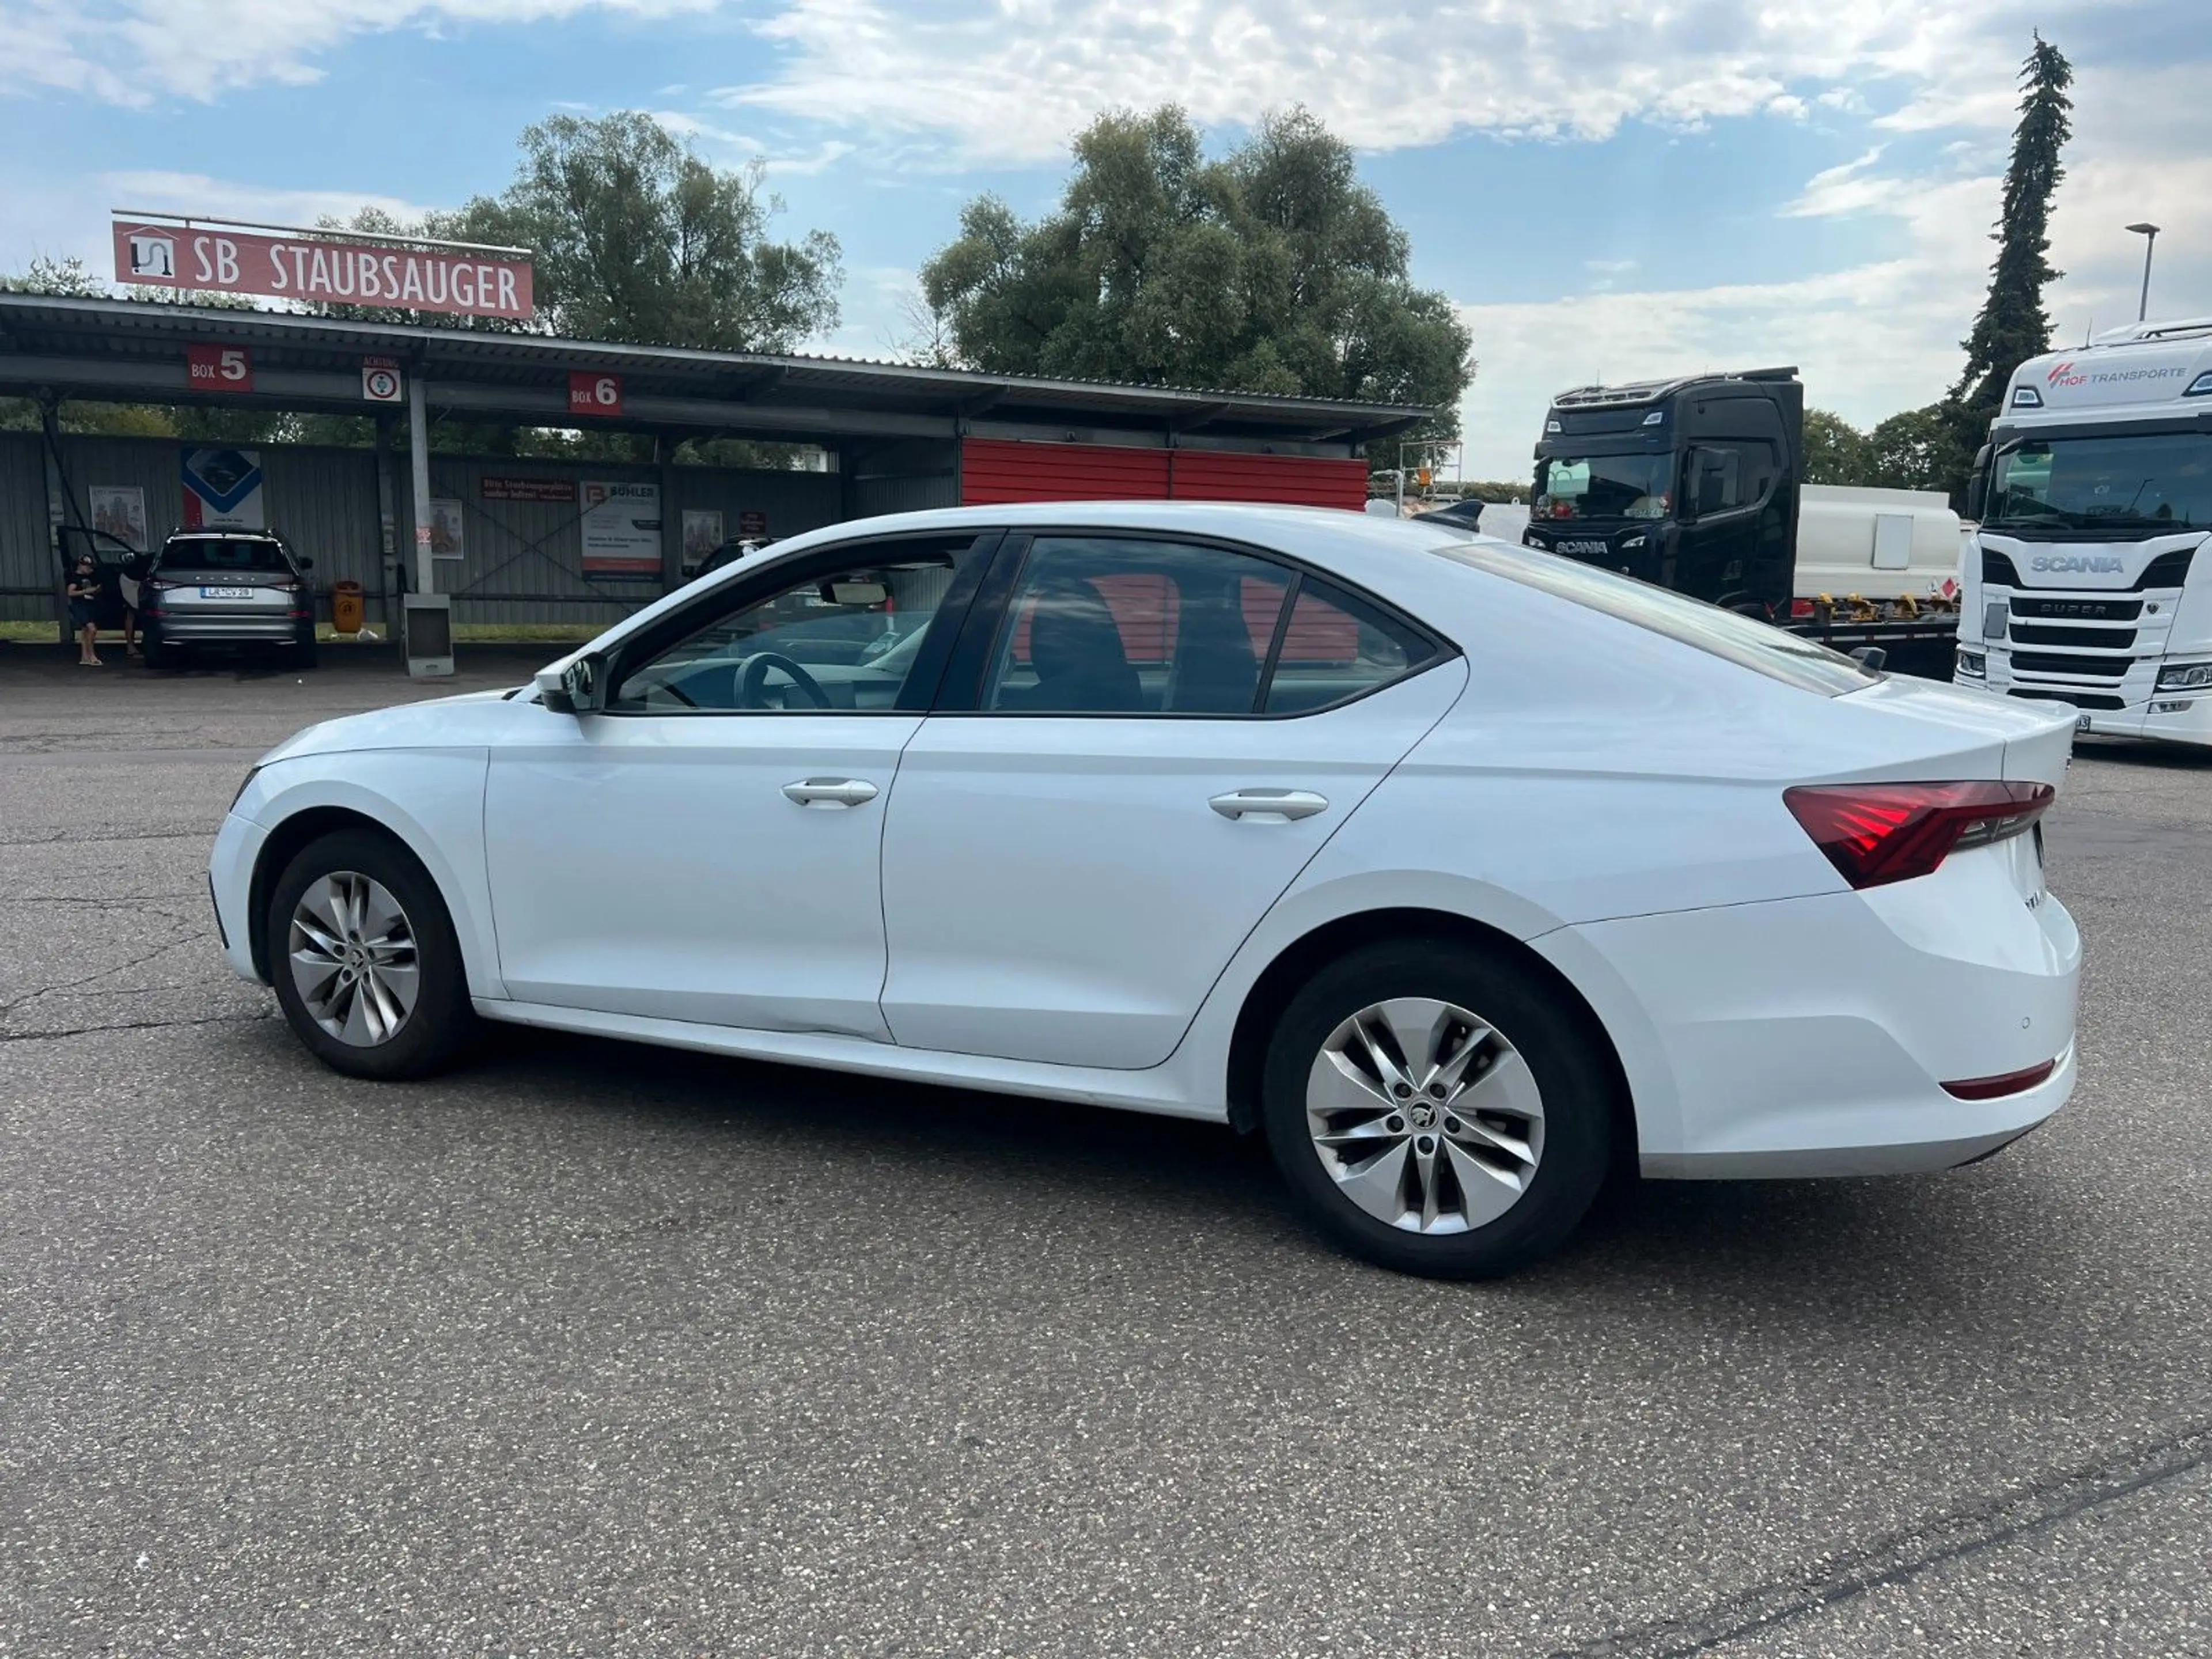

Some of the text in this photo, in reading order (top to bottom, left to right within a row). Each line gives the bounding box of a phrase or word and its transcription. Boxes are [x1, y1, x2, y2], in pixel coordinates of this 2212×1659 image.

[194, 236, 520, 311] SB STAUBSAUGER
[191, 350, 247, 380] BOX 5
[2059, 368, 2187, 387] HOF TRANSPORTE
[572, 378, 617, 405] BOX 6
[1556, 541, 1608, 554] SCANIA
[2031, 556, 2124, 573] SCANIA
[2040, 604, 2107, 615] SUPER
